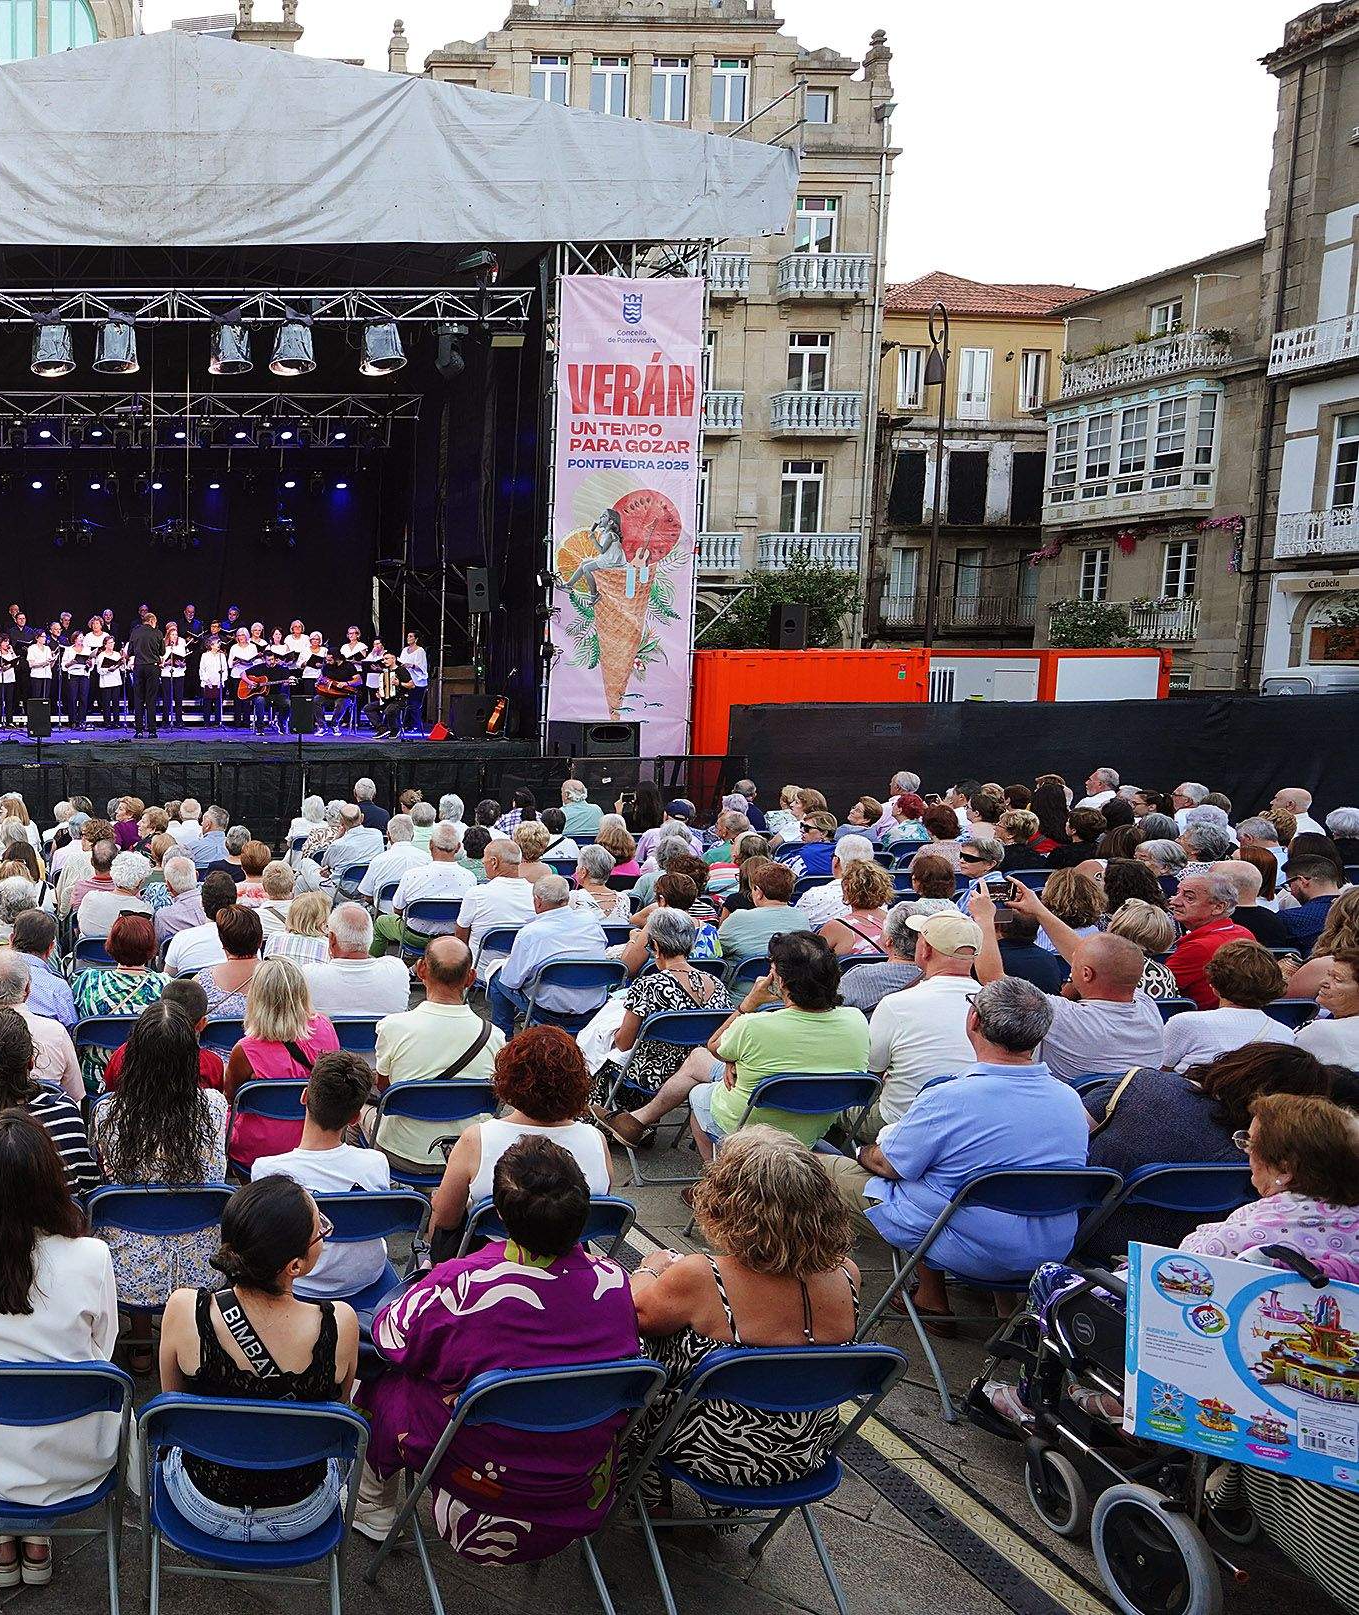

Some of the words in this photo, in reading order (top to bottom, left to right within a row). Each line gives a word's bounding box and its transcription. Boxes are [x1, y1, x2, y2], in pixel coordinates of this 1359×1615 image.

[617, 336, 657, 344] Pontevedra
[567, 352, 695, 417] VERÁN
[570, 421, 598, 436] UN
[598, 422, 663, 437] TEMPO
[569, 438, 624, 453] PARA
[625, 439, 690, 454] GOZAR
[567, 458, 656, 470] PONTEVEDRA
[657, 459, 690, 471] 2025
